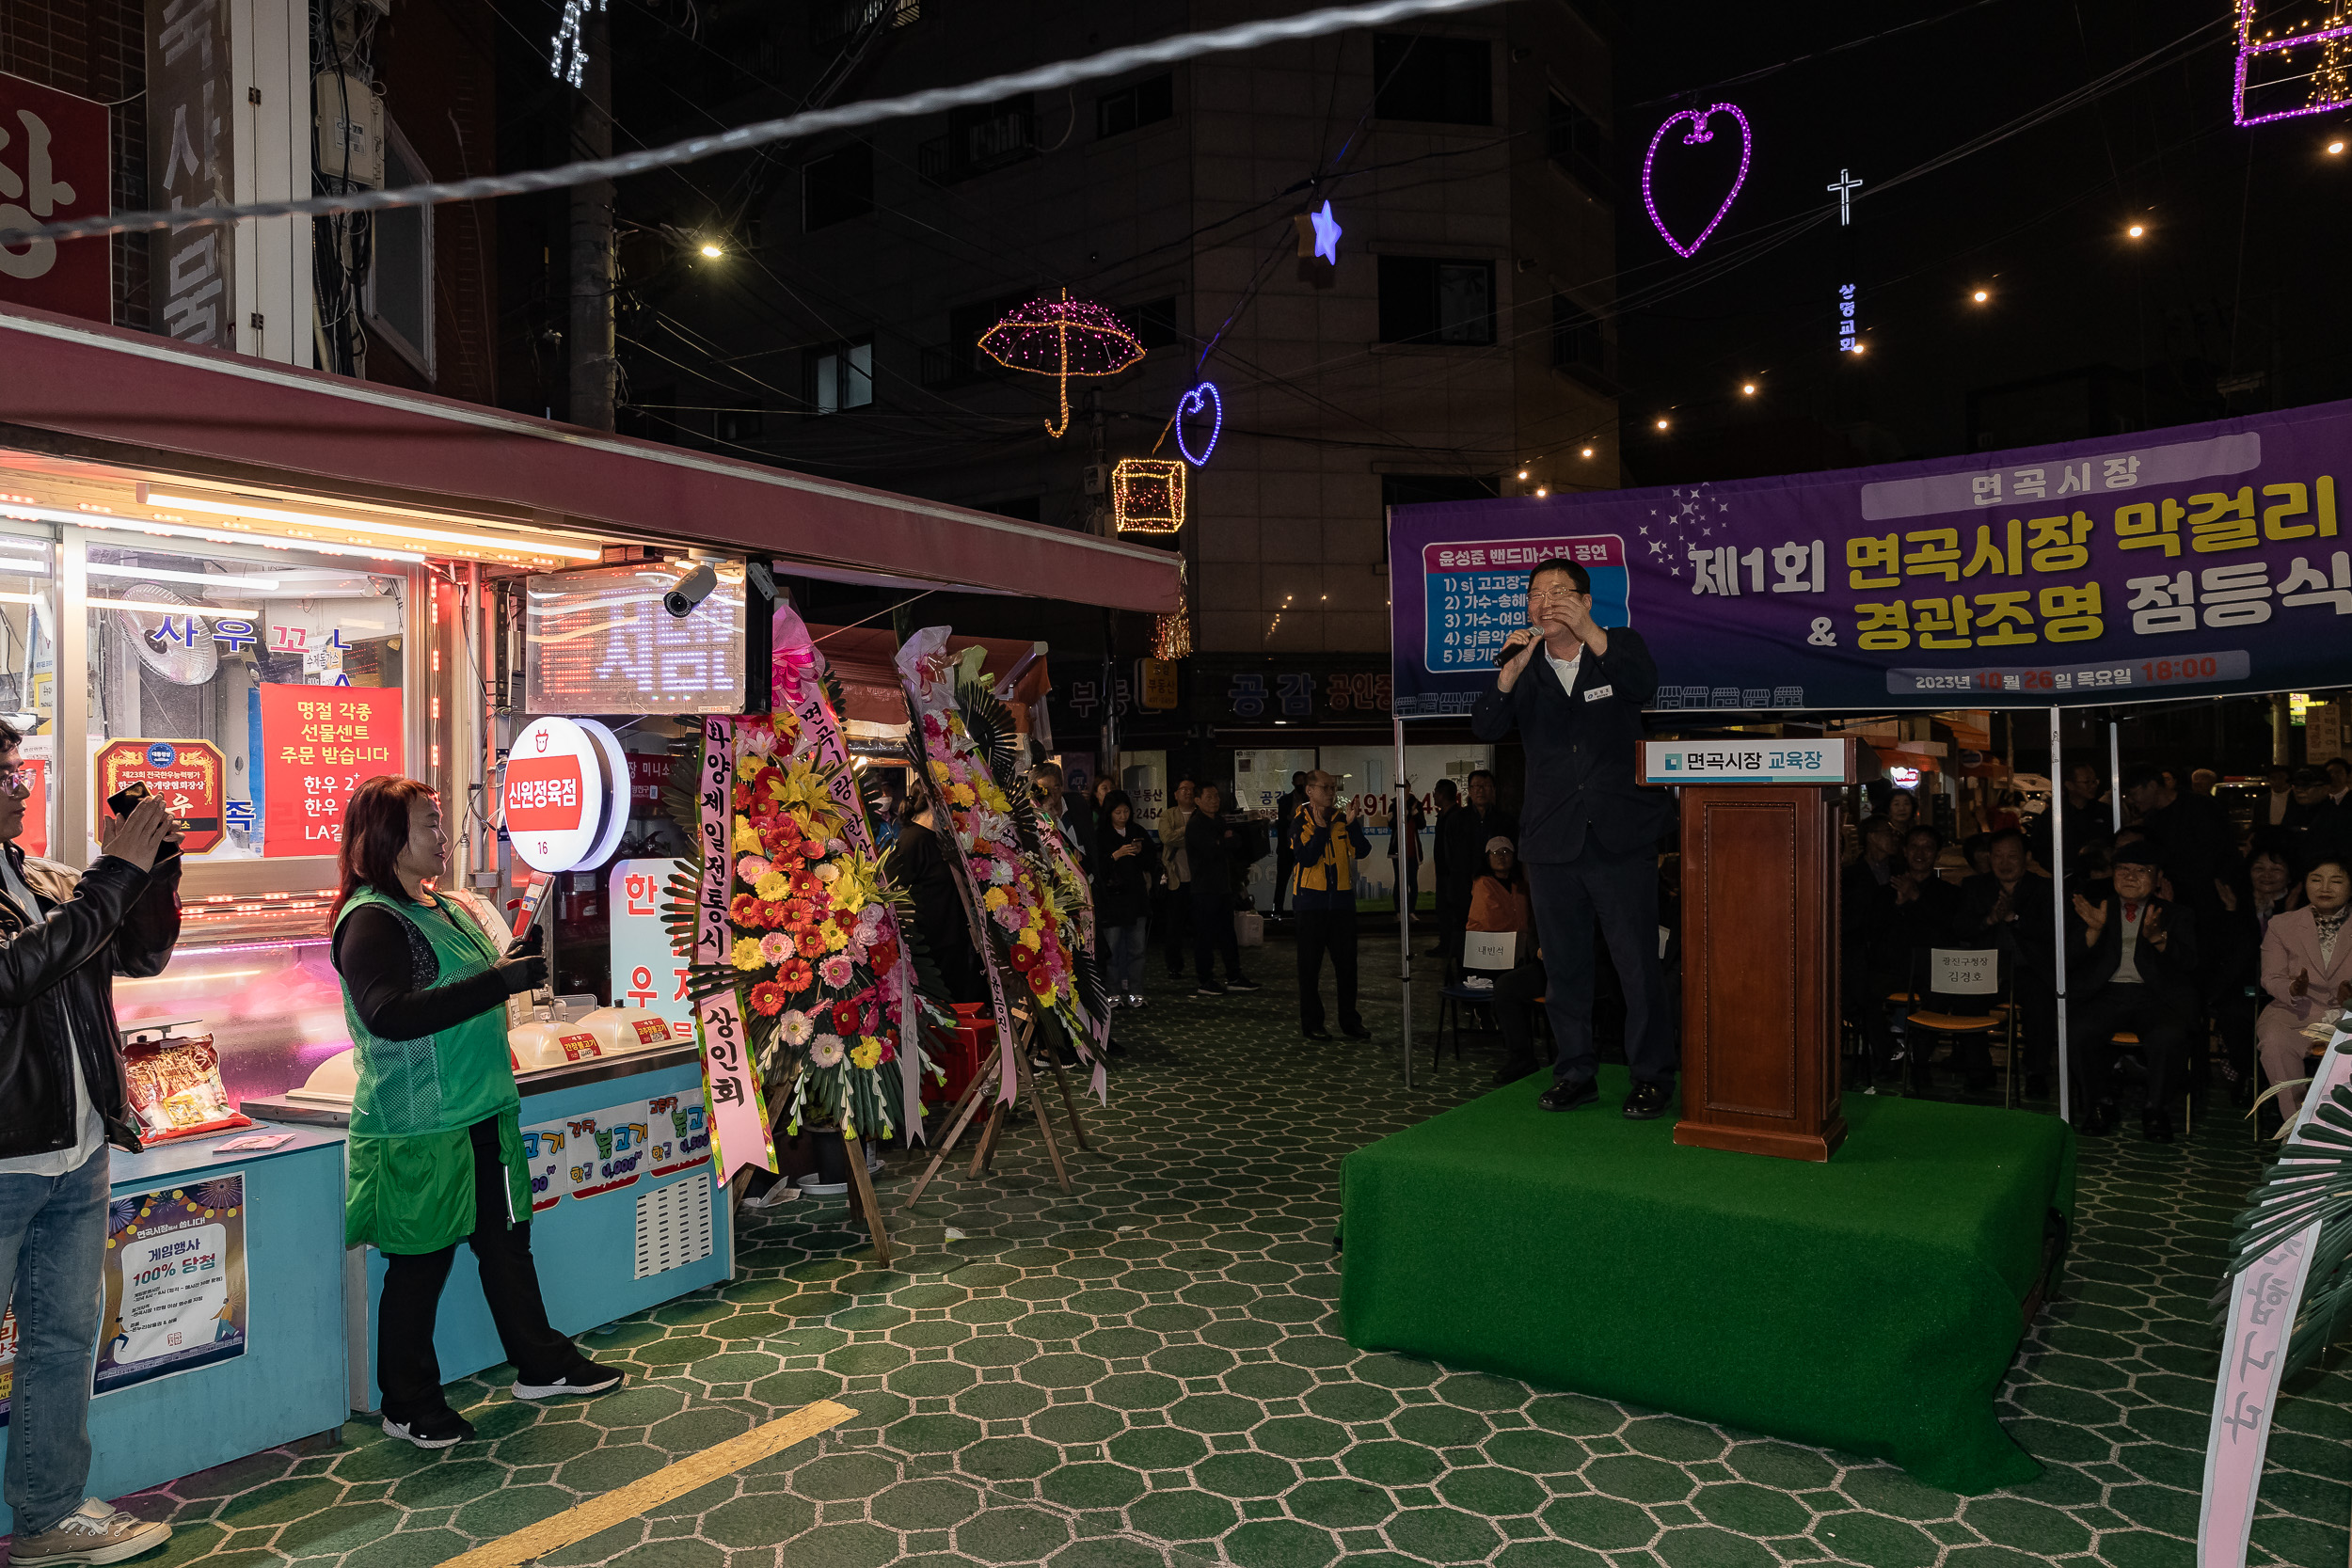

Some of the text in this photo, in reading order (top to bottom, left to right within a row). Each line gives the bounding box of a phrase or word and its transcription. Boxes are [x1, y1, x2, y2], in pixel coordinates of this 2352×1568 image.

[1971, 455, 2141, 506] 면곡시장
[1688, 475, 2338, 596] 제1회 면곡시장 막걸리
[1438, 549, 1486, 567] 윤성준
[1574, 544, 1608, 562] 공연
[1443, 578, 1457, 593] 1)
[1460, 578, 1474, 594] sj
[1444, 594, 1529, 610] 2) 가수-송혜
[1807, 550, 2352, 651] & 경관조명 점등식
[1444, 611, 1532, 628] 3) 가수-여의
[152, 614, 199, 649] 사
[213, 618, 257, 652] 우
[269, 626, 310, 654] 꼬
[1443, 631, 1460, 646] 4)
[1915, 657, 2217, 691] 2023년 10월 26일 목요일 18:00
[1148, 678, 1175, 694] 부동산
[1228, 672, 1317, 718] 공감
[297, 701, 373, 722] 명절 각종
[301, 723, 370, 743] 선물센트
[280, 745, 389, 767] 주문 받습니다
[1686, 751, 1823, 770] 면곡시장 교육장
[303, 775, 339, 795] 한우
[508, 778, 577, 809] 신원정육점
[631, 784, 649, 794] 광진구
[225, 800, 256, 833] 족
[304, 798, 340, 817] 한우
[537, 841, 548, 855] 16
[1478, 945, 1504, 957] 내빈석
[1942, 957, 1989, 967] 광진구청장
[1947, 971, 1983, 983] 김경호
[564, 1038, 597, 1052] 간장불고기
[703, 1006, 745, 1108] 상인회
[566, 1118, 596, 1138] 간장
[671, 1105, 706, 1138] 불고
[594, 1122, 647, 1160] 불고기
[148, 1238, 200, 1263] 게임행사
[133, 1253, 215, 1288] 100% 당첨
